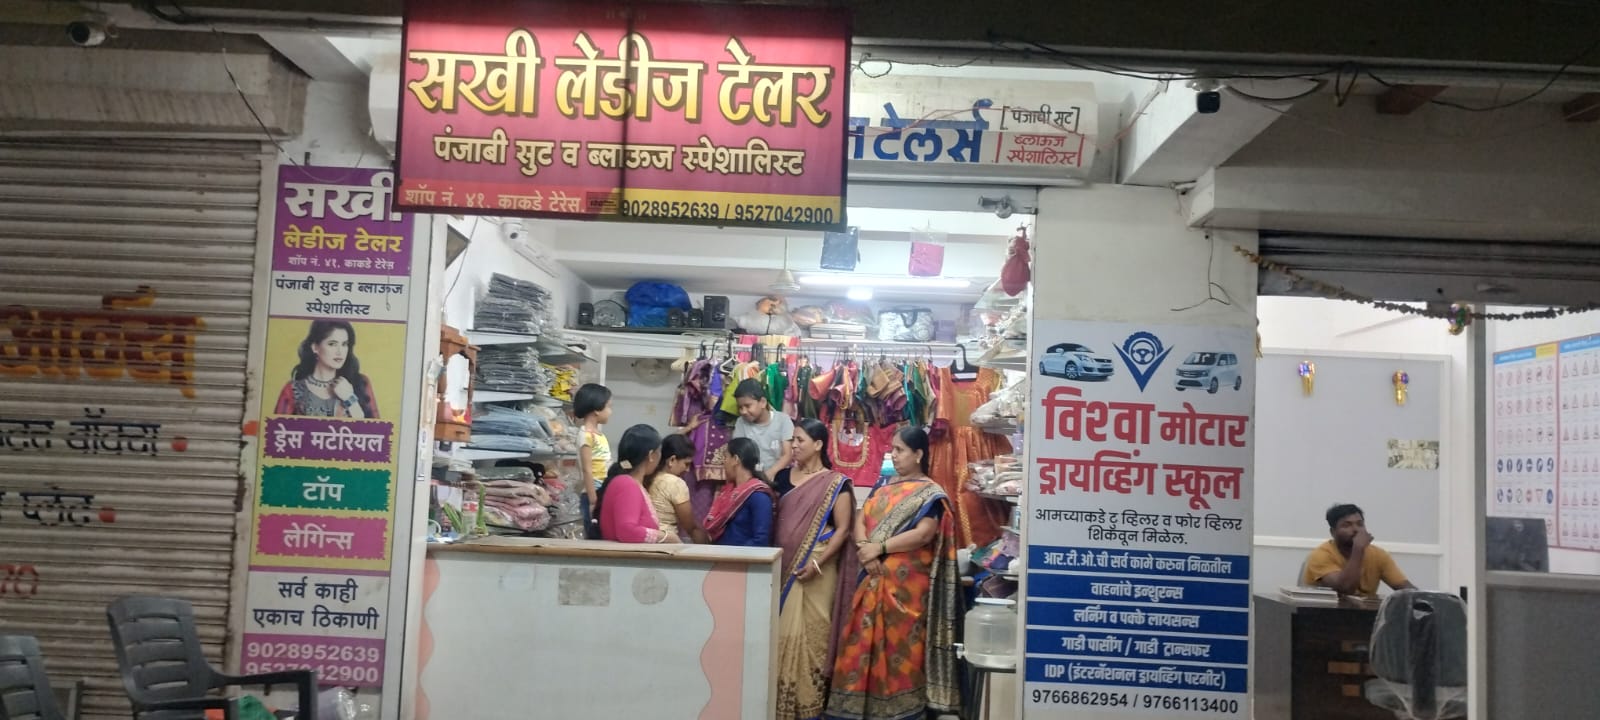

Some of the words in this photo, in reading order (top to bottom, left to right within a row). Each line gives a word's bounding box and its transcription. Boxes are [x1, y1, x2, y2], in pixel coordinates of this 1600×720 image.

[408, 28, 542, 115] सखी
[555, 32, 704, 121] लेडीज
[718, 37, 832, 125] टेलर
[873, 98, 993, 163] टेलर्स
[434, 126, 508, 165] पंजाबी
[515, 140, 555, 175] सुट
[561, 141, 580, 167] व
[587, 141, 674, 170] ब्लाऊज
[682, 137, 806, 175] स्पेशालिस्ट
[284, 171, 402, 221] सखी
[405, 184, 436, 206] शॉप
[498, 190, 543, 211] काकडे
[622, 200, 719, 219] 9028952639
[735, 205, 833, 225] 9527042900
[282, 224, 347, 250] लेडीज
[354, 227, 404, 252] टेलर
[276, 274, 315, 290] पंजाबी
[320, 281, 340, 295] सुट
[344, 282, 354, 292] व
[306, 298, 371, 315] स्पेशालिस्ट
[1158, 401, 1249, 447] मोटार
[274, 423, 304, 453] ड्रेस
[311, 425, 385, 452] मटेरियल
[302, 475, 344, 501] टॉप
[1036, 449, 1158, 496] ड्रायव्हिंग
[1162, 463, 1244, 510] स्कूल
[1035, 508, 1106, 524] आमच्याकडे
[1163, 514, 1171, 526] व
[1175, 513, 1201, 528] फोर
[278, 576, 308, 598] सर्व
[315, 578, 358, 603] काही
[253, 608, 304, 628] एकाच
[312, 605, 380, 630] ठिकाणी
[1109, 611, 1118, 624] व
[247, 642, 380, 663] 9028952639
[1061, 634, 1086, 651] गाडी
[1134, 637, 1159, 654] गाडी
[1044, 664, 1065, 679] IDP
[1032, 689, 1128, 707] 9766862954
[1143, 696, 1238, 714] 9766113400
